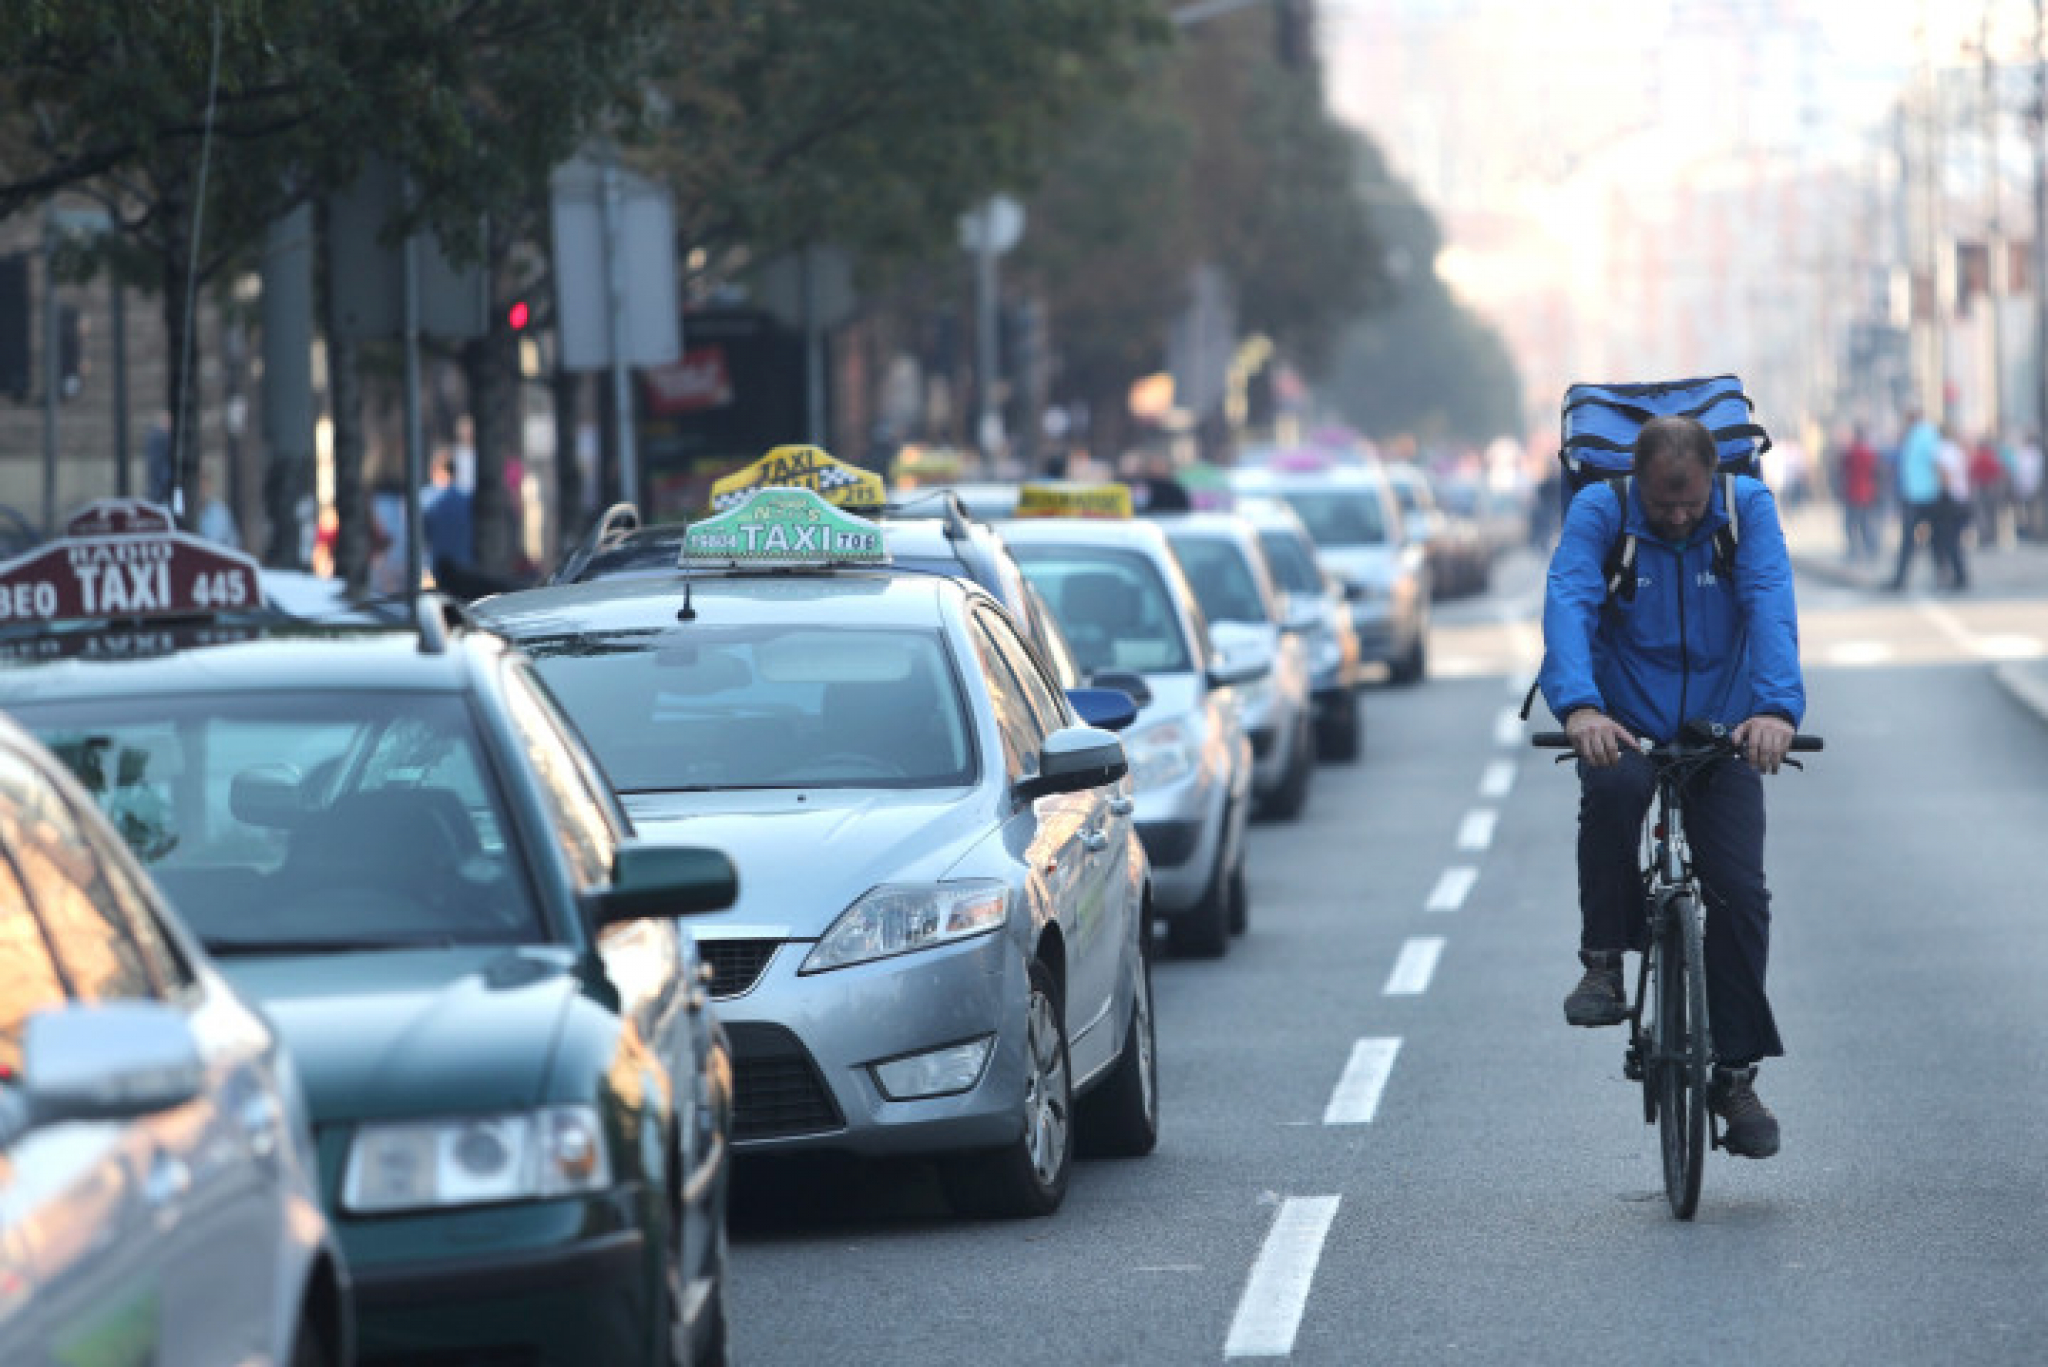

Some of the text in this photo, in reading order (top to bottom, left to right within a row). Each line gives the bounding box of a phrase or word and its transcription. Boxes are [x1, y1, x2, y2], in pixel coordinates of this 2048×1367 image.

[760, 450, 815, 478] TAXI
[738, 523, 833, 551] TAXI
[67, 543, 173, 564] RADIO
[75, 561, 173, 615] TAXI
[191, 570, 248, 606] 445
